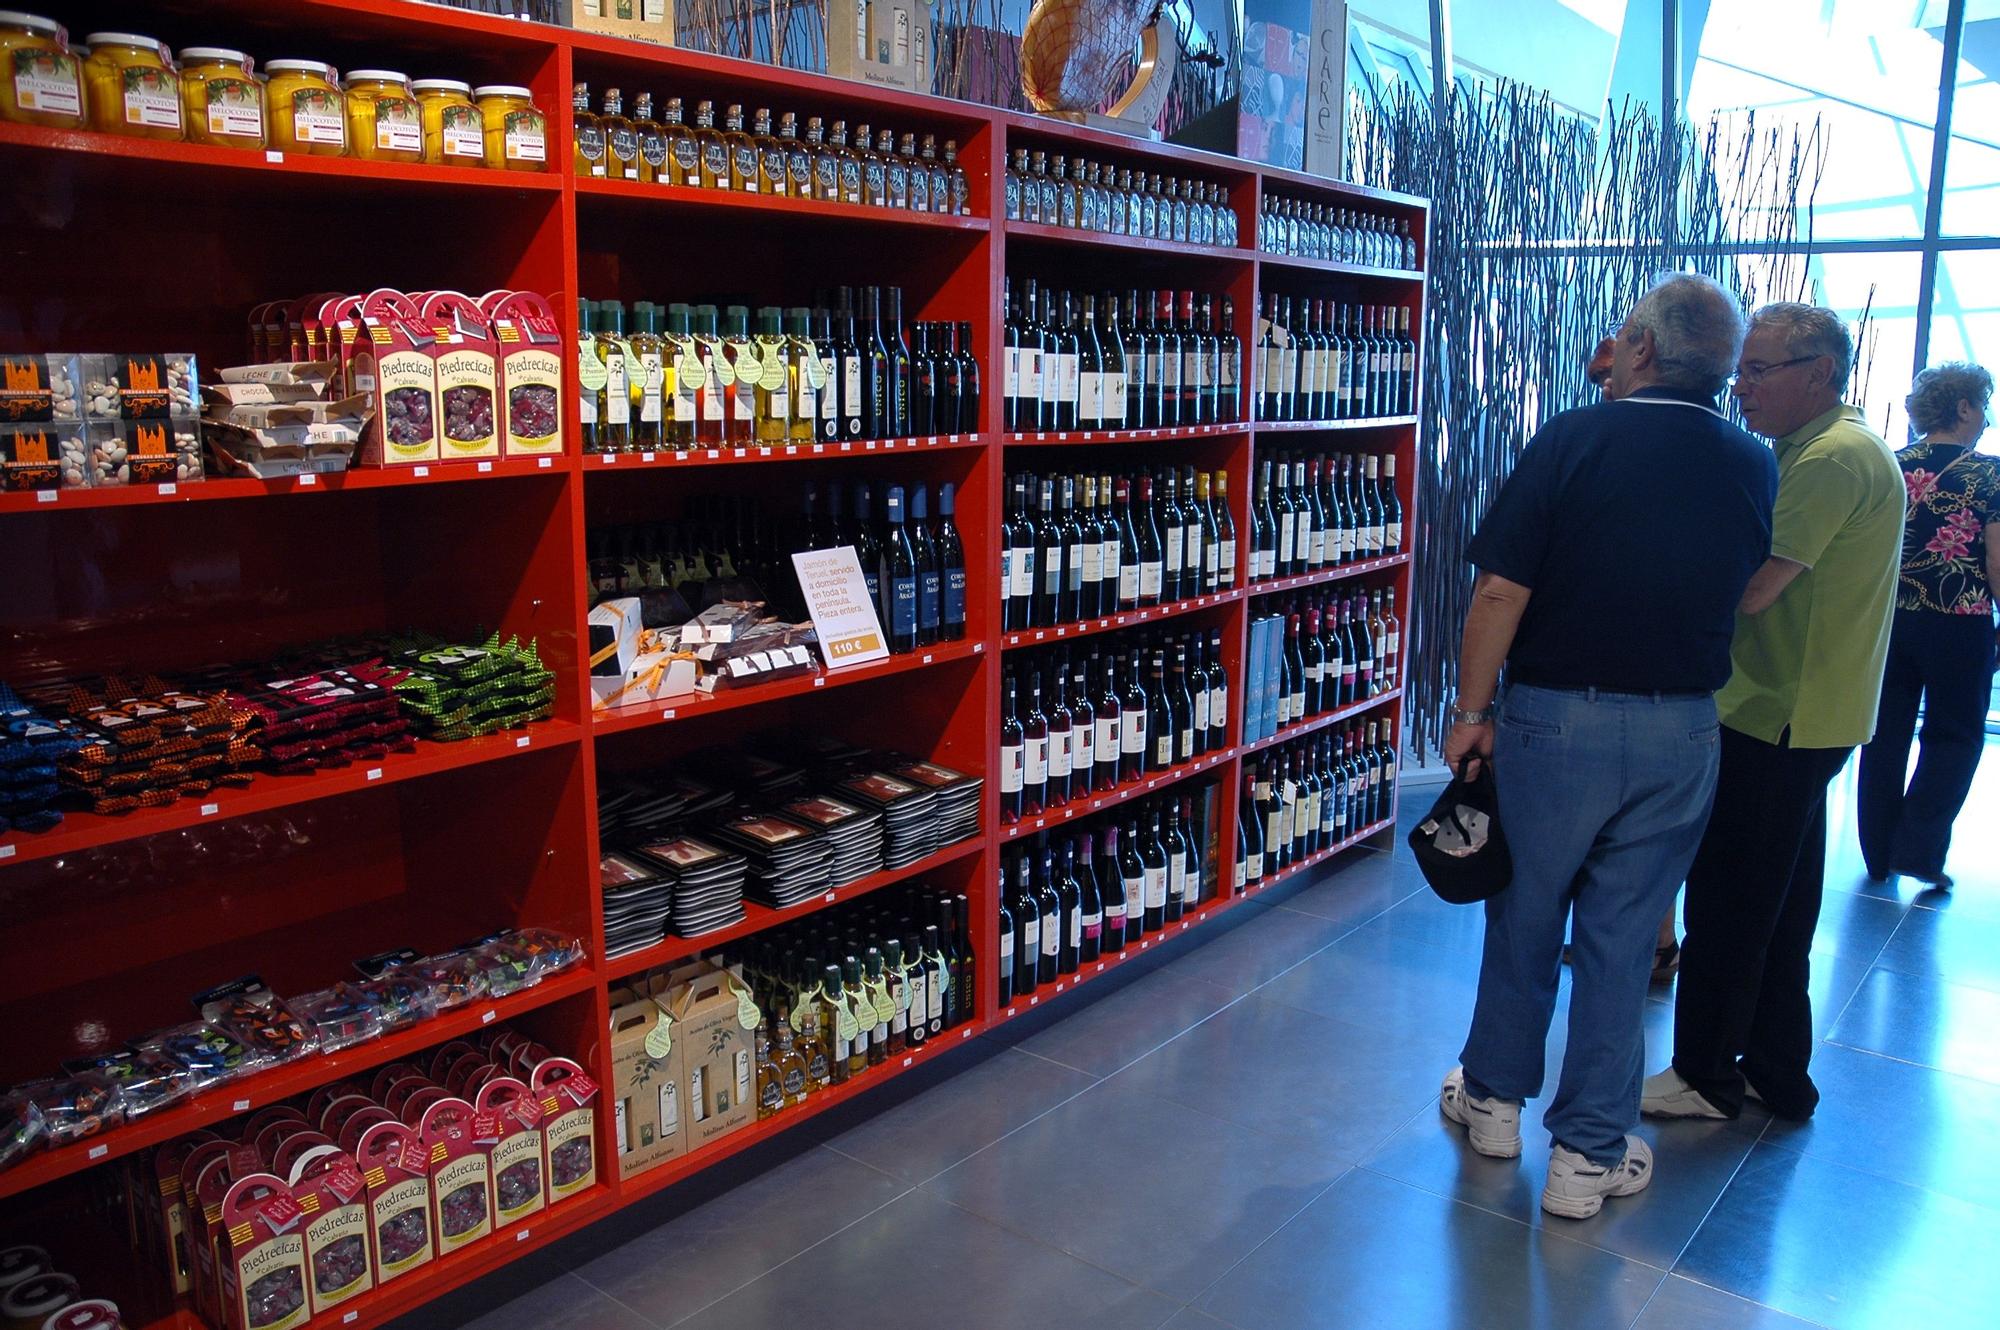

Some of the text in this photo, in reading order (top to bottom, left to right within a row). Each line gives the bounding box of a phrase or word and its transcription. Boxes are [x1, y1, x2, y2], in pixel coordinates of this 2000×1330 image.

[242, 371, 268, 379] LECHE
[812, 586, 848, 600] en toda la
[817, 609, 839, 620] Pieza
[834, 640, 862, 654] 110 €
